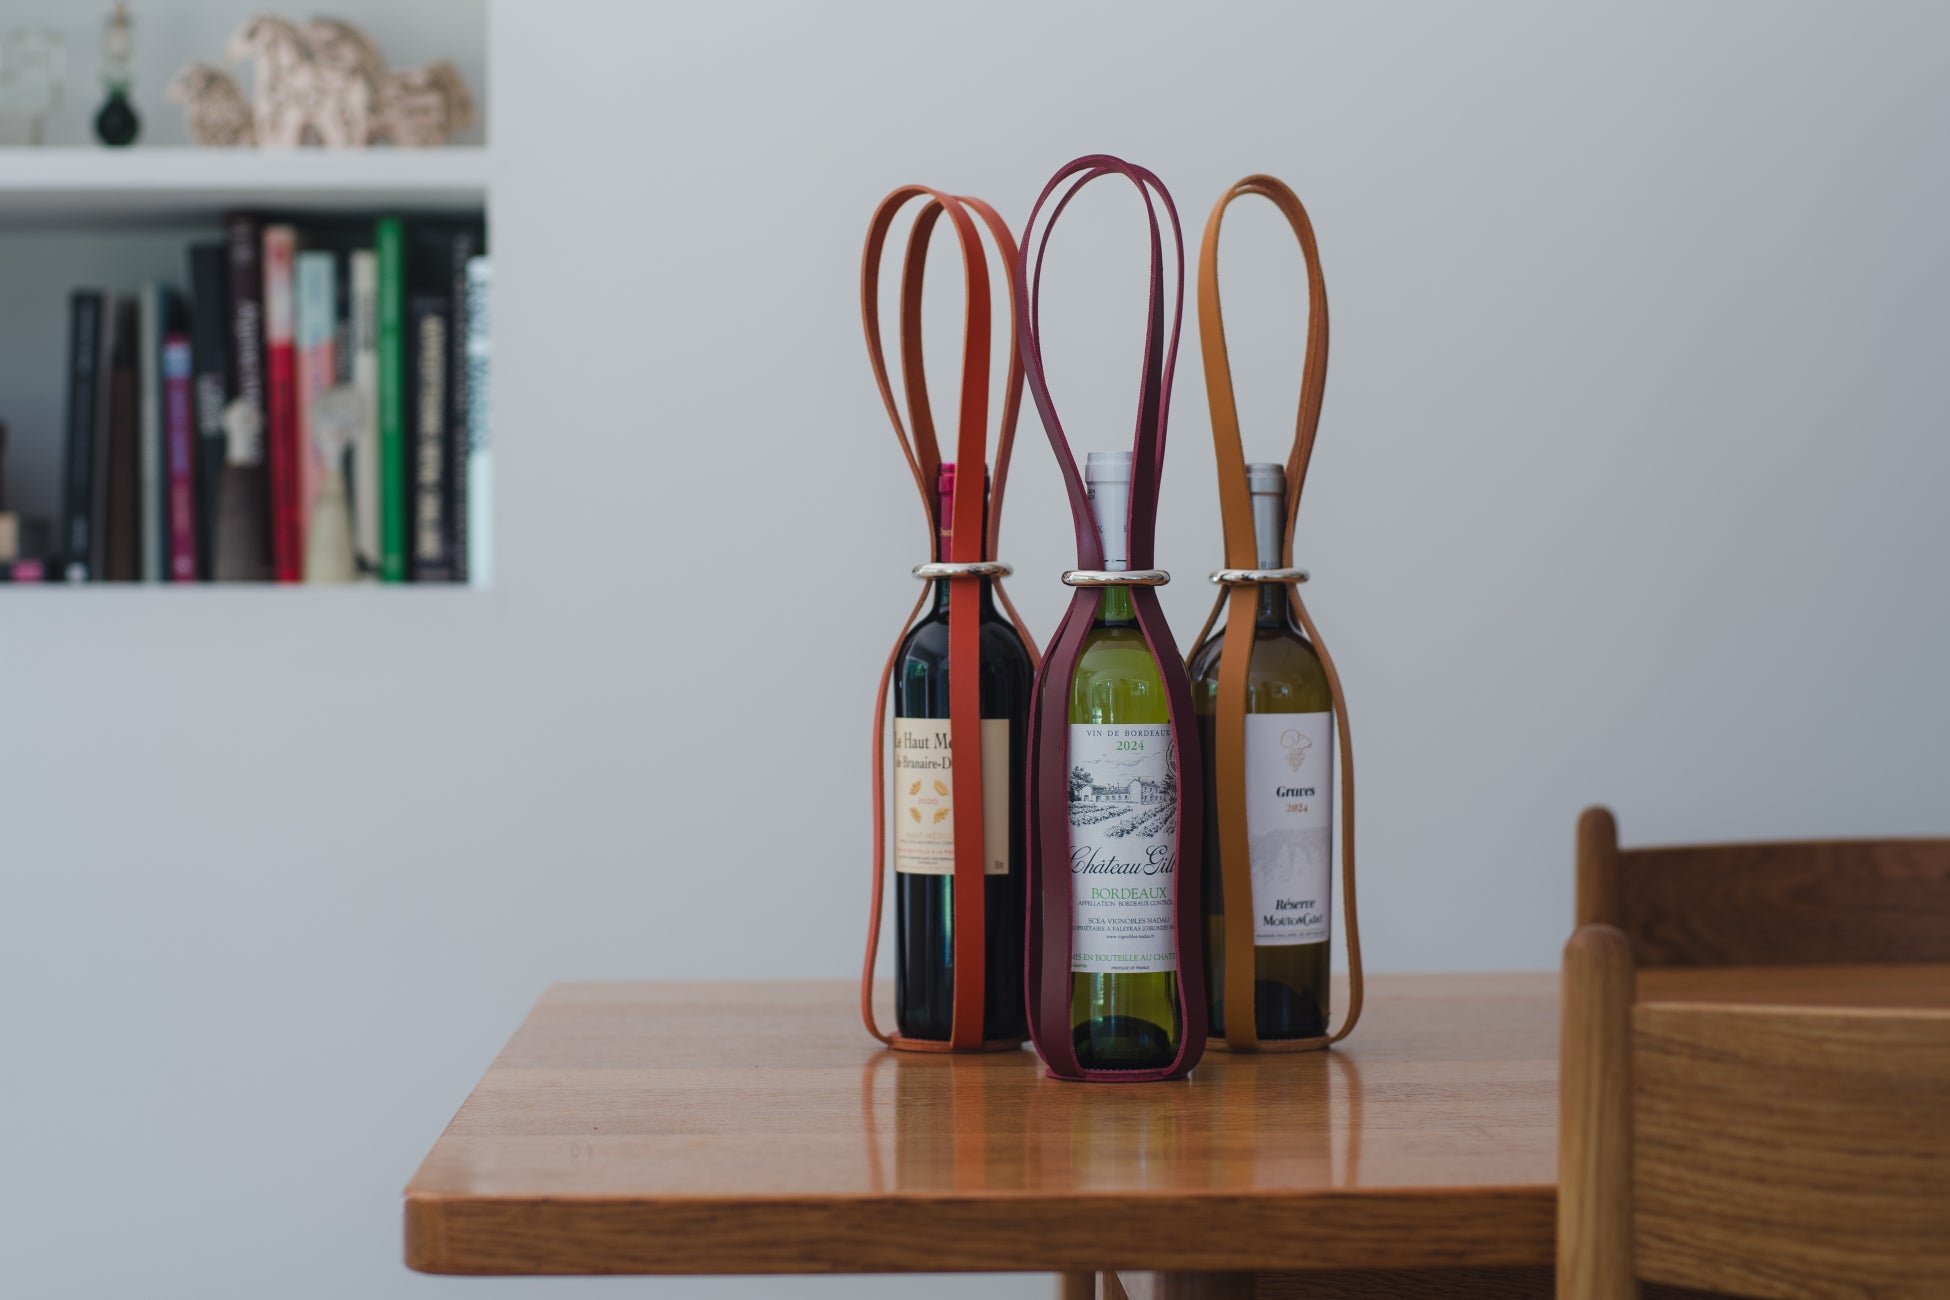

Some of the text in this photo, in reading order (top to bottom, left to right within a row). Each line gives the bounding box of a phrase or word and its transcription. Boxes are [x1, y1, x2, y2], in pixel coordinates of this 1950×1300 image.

[1086, 729, 1102, 737] VIN
[1124, 729, 1170, 737] BORDEAUX
[904, 732, 929, 749] Haut
[1116, 740, 1145, 751] 2024
[1276, 785, 1315, 798] Graves
[1070, 845, 1142, 875] Château
[1091, 887, 1167, 899] BORDEAUX
[1275, 898, 1316, 911] Réserve
[1107, 917, 1146, 925] VIGNOBLES
[1147, 916, 1170, 924] NADAU
[1083, 953, 1094, 961] EN
[1095, 954, 1139, 962] BOUTEILLE
[1141, 953, 1151, 962] AU
